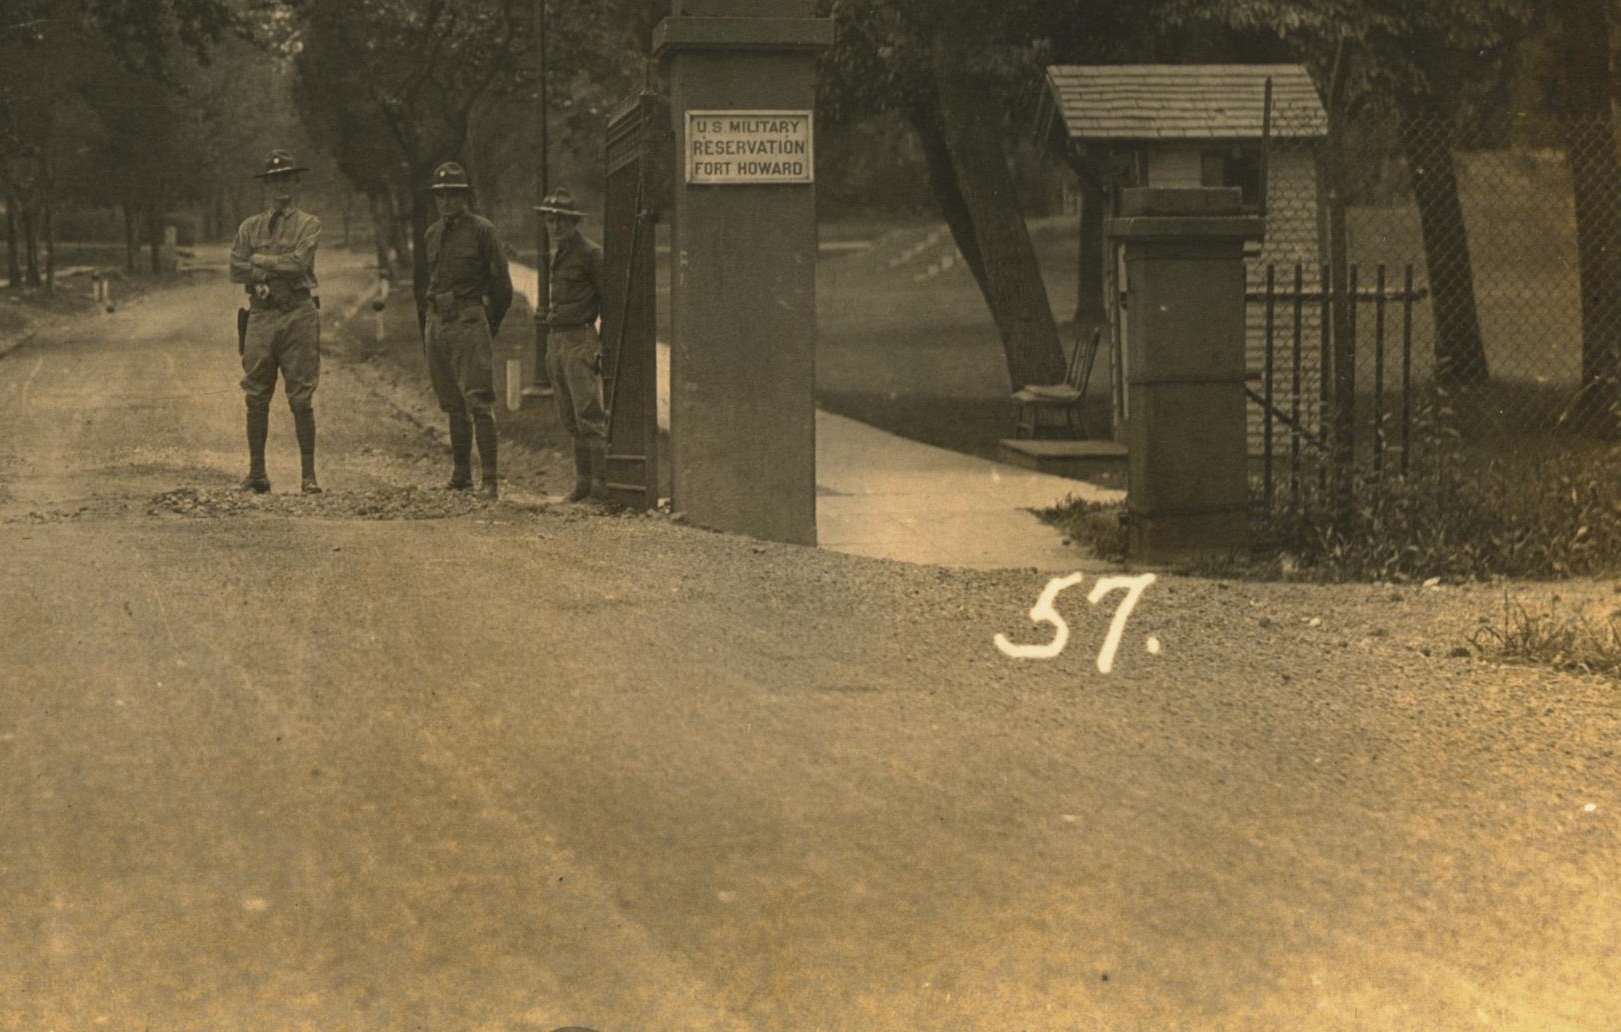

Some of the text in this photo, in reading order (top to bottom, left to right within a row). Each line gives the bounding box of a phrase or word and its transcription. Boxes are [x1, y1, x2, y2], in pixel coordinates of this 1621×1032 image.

[729, 120, 800, 133] MILITARY
[693, 140, 805, 156] RESERVATION
[694, 162, 803, 175] FORT HOWARD
